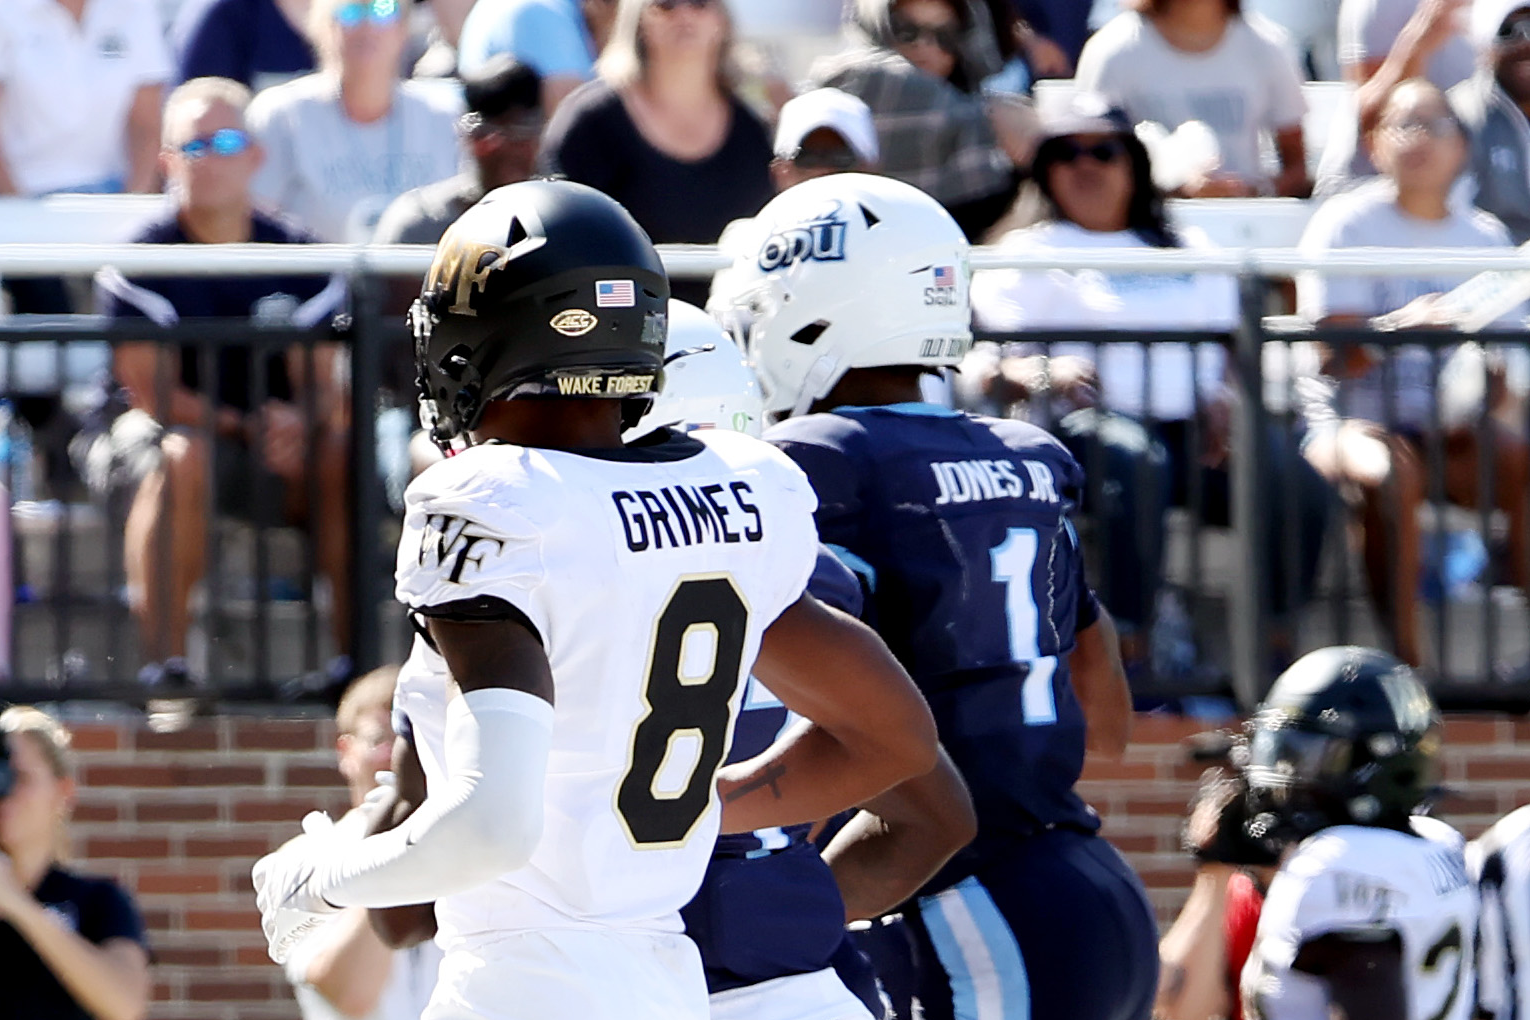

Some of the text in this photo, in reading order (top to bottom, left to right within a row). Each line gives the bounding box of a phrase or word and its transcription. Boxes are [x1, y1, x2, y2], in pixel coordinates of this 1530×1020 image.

[759, 220, 847, 273] ODU
[557, 375, 654, 396] WAKE FOREST
[930, 459, 1024, 504] JONES
[611, 481, 763, 552] GRIMES
[988, 526, 1059, 726] 1
[612, 571, 752, 851] 8
